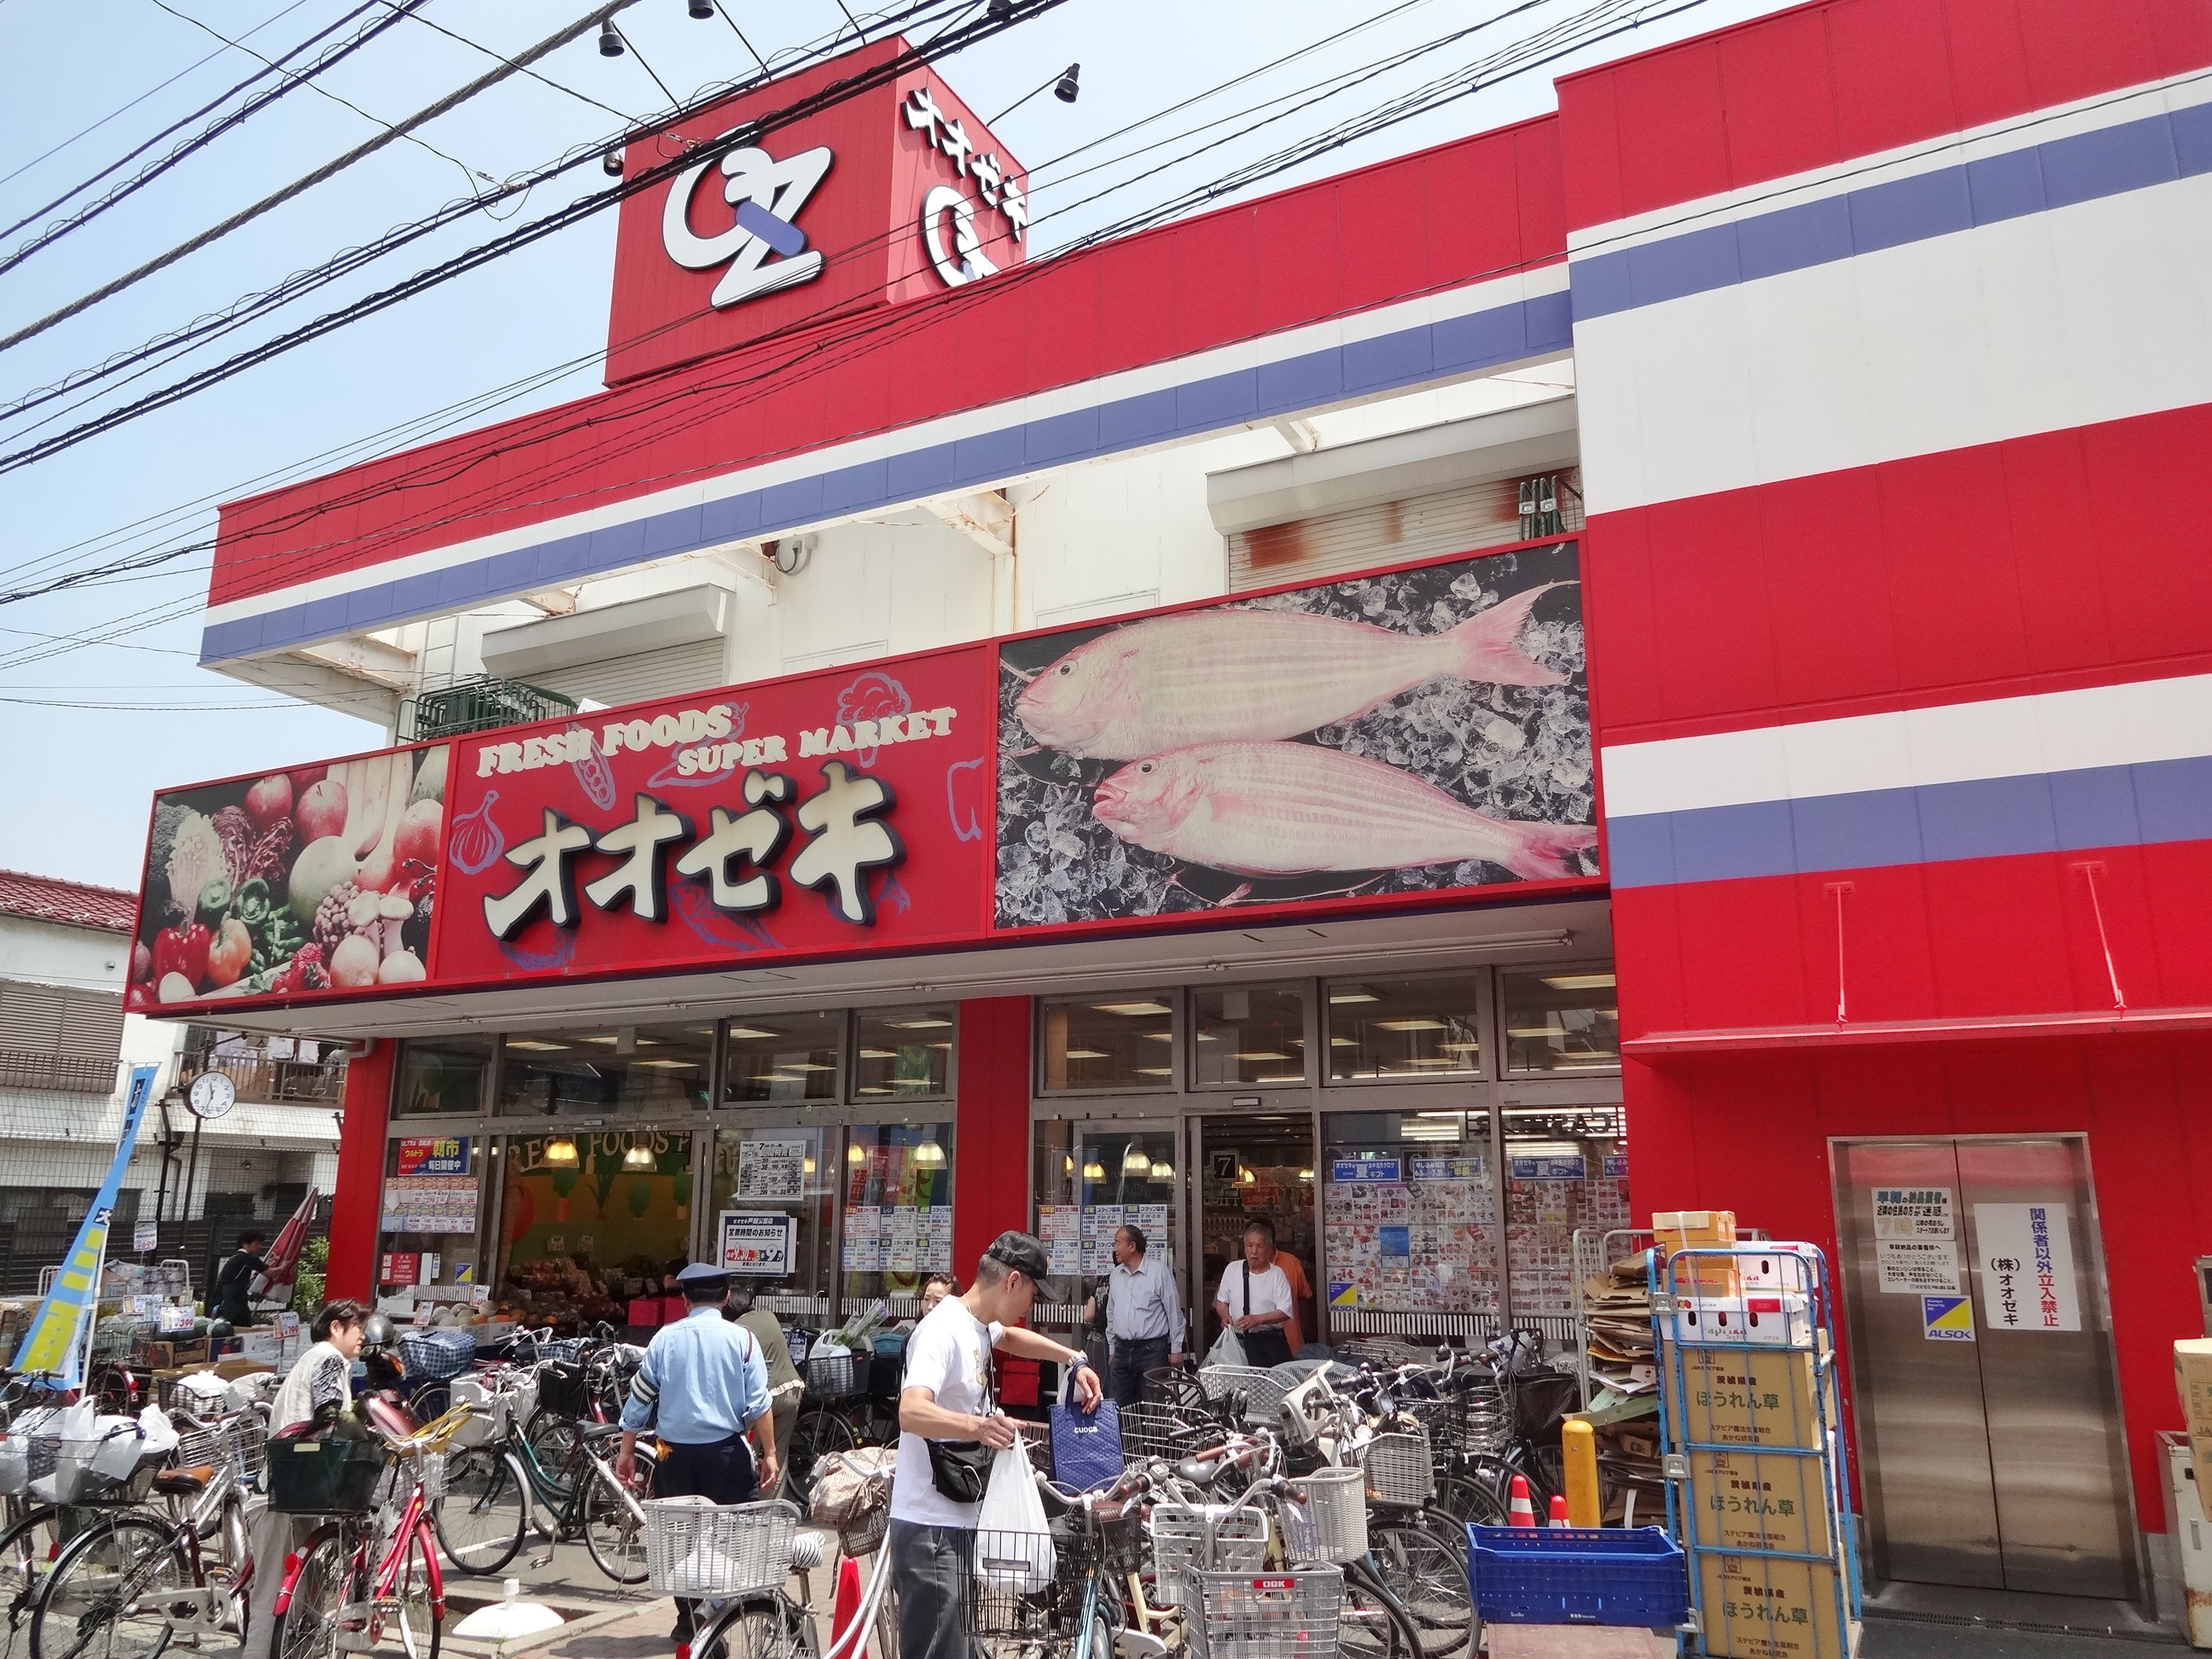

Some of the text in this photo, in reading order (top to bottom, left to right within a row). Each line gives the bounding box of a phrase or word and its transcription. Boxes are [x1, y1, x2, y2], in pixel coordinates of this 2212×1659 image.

[901, 87, 1029, 243] オオゼキ
[476, 705, 731, 777] FRESH FOODS
[677, 707, 958, 777] SUPER MARKET
[483, 759, 906, 940] オオゼキ
[433, 1139, 460, 1158] 朝市
[428, 1160, 461, 1171] 毎日開催中
[1218, 1157, 1231, 1176] 7
[1355, 1163, 1369, 1179] 夏
[1537, 1161, 1550, 1176] 夏
[728, 1228, 783, 1237] 営業時間のお知らせ
[1877, 1218, 1913, 1236] 7時
[2029, 1208, 2059, 1327] 関係者以外立入禁止
[1991, 1258, 2021, 1325] (株)オオゼキ
[1929, 1330, 1972, 1339] ALSOK
[1716, 1376, 1757, 1386] 茨城県産
[1697, 1390, 1779, 1411] ほうれん草
[1731, 1479, 1772, 1492] 茨城県産
[1710, 1494, 1795, 1516] ほうれん草
[1743, 1586, 1785, 1598] 茨城県産
[1722, 1601, 1808, 1625] ほうれん草
